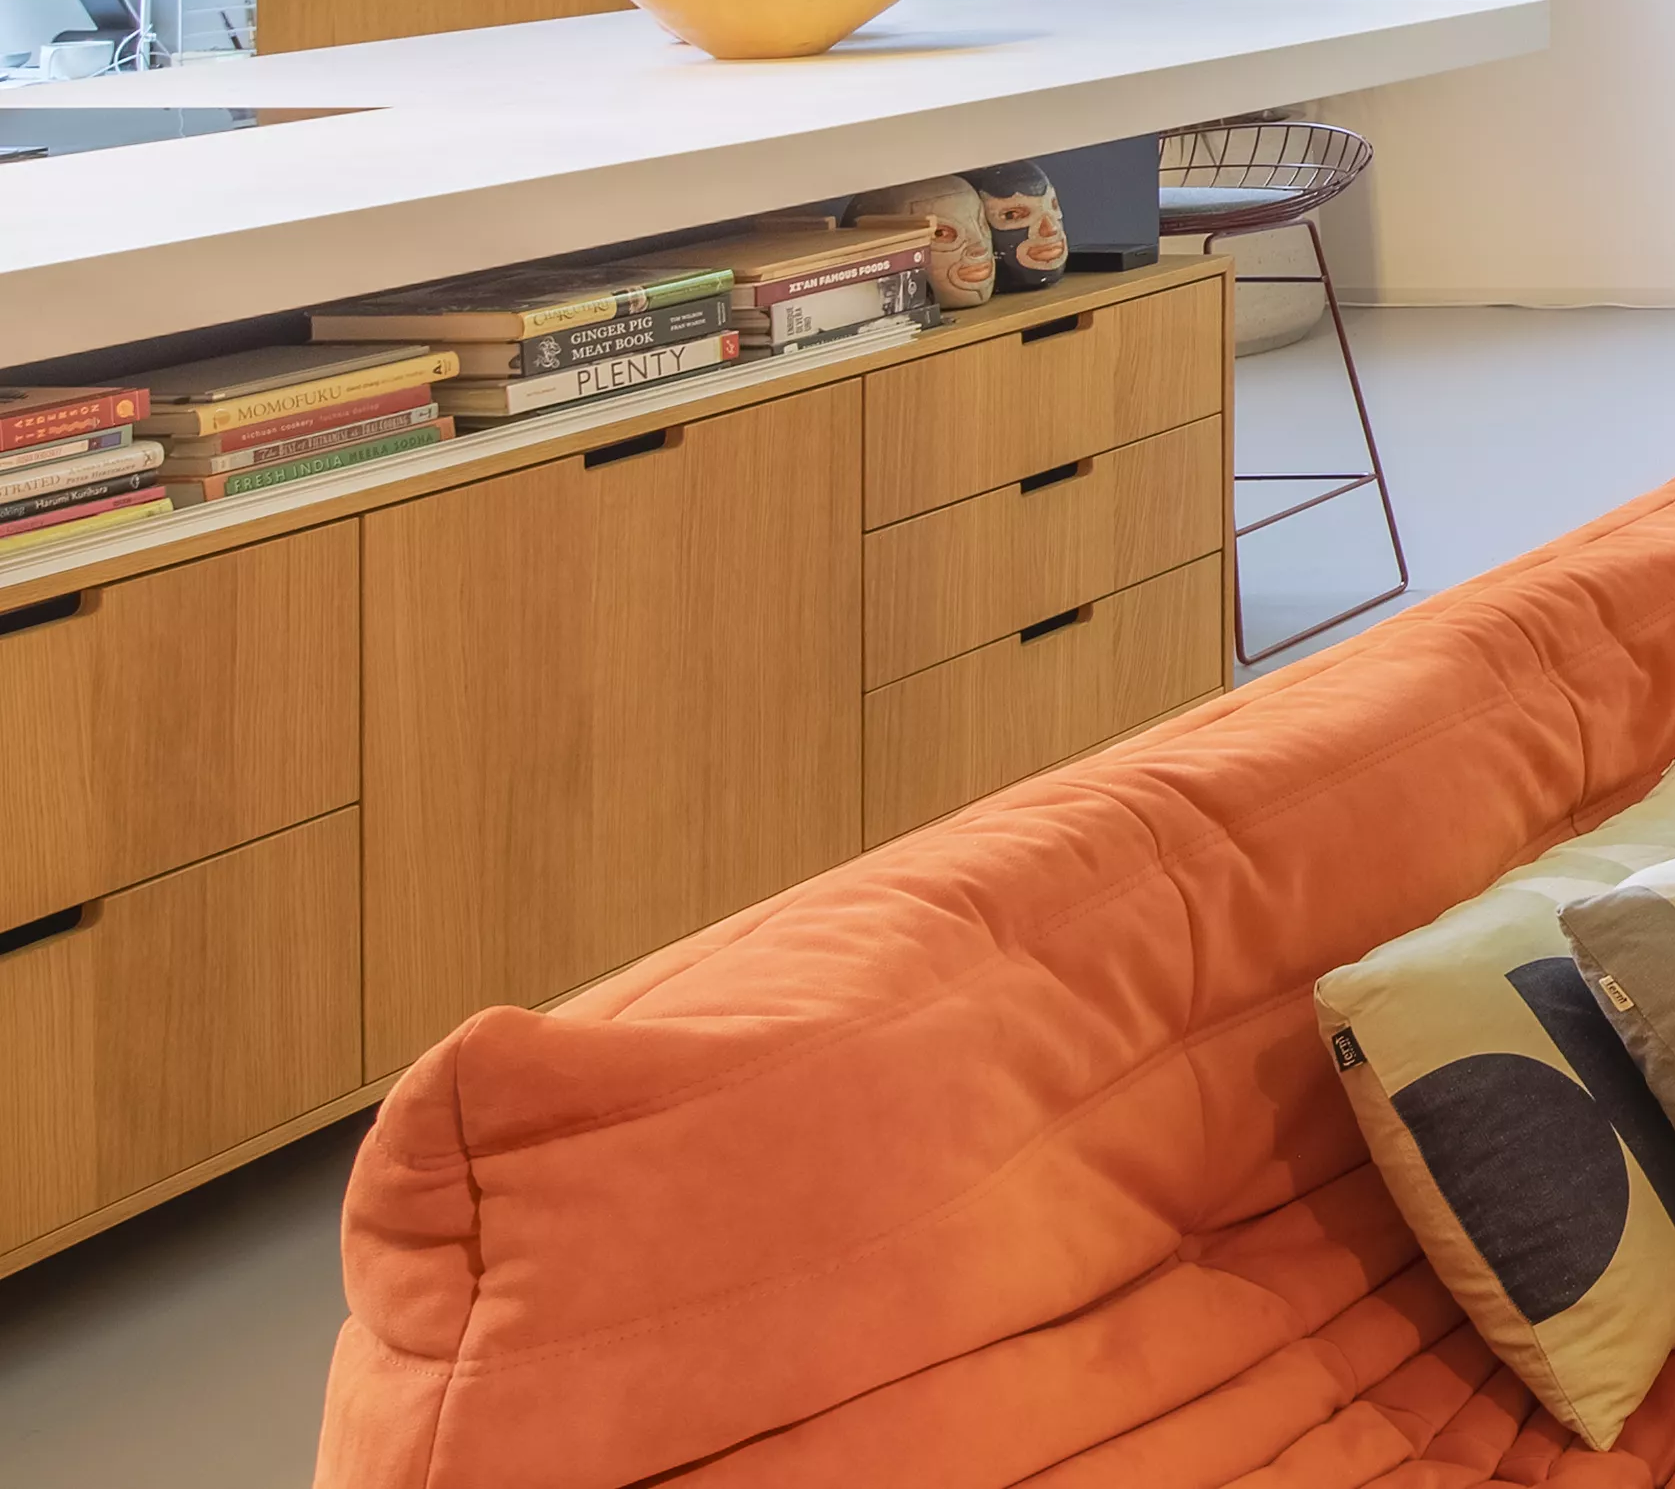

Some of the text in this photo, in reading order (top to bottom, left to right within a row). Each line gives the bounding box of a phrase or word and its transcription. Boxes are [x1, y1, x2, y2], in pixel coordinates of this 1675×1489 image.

[788, 260, 891, 294] XI'AN FAMOUS FOODS
[570, 316, 653, 345] GINGER PIG
[571, 331, 654, 361] MEAT BOOK
[577, 346, 686, 395] PLENTY
[14, 403, 100, 428] ANDERSON
[237, 385, 341, 422] MOMOFUKU
[241, 426, 278, 441] sichuan
[280, 419, 314, 432] cookery
[234, 433, 434, 493] FRESH INDIA MEERA SODHA
[35, 493, 70, 509] Harumi
[71, 485, 108, 500] Kurihara
[1606, 981, 1628, 1004] ferm
[1335, 1035, 1356, 1066] ferm
